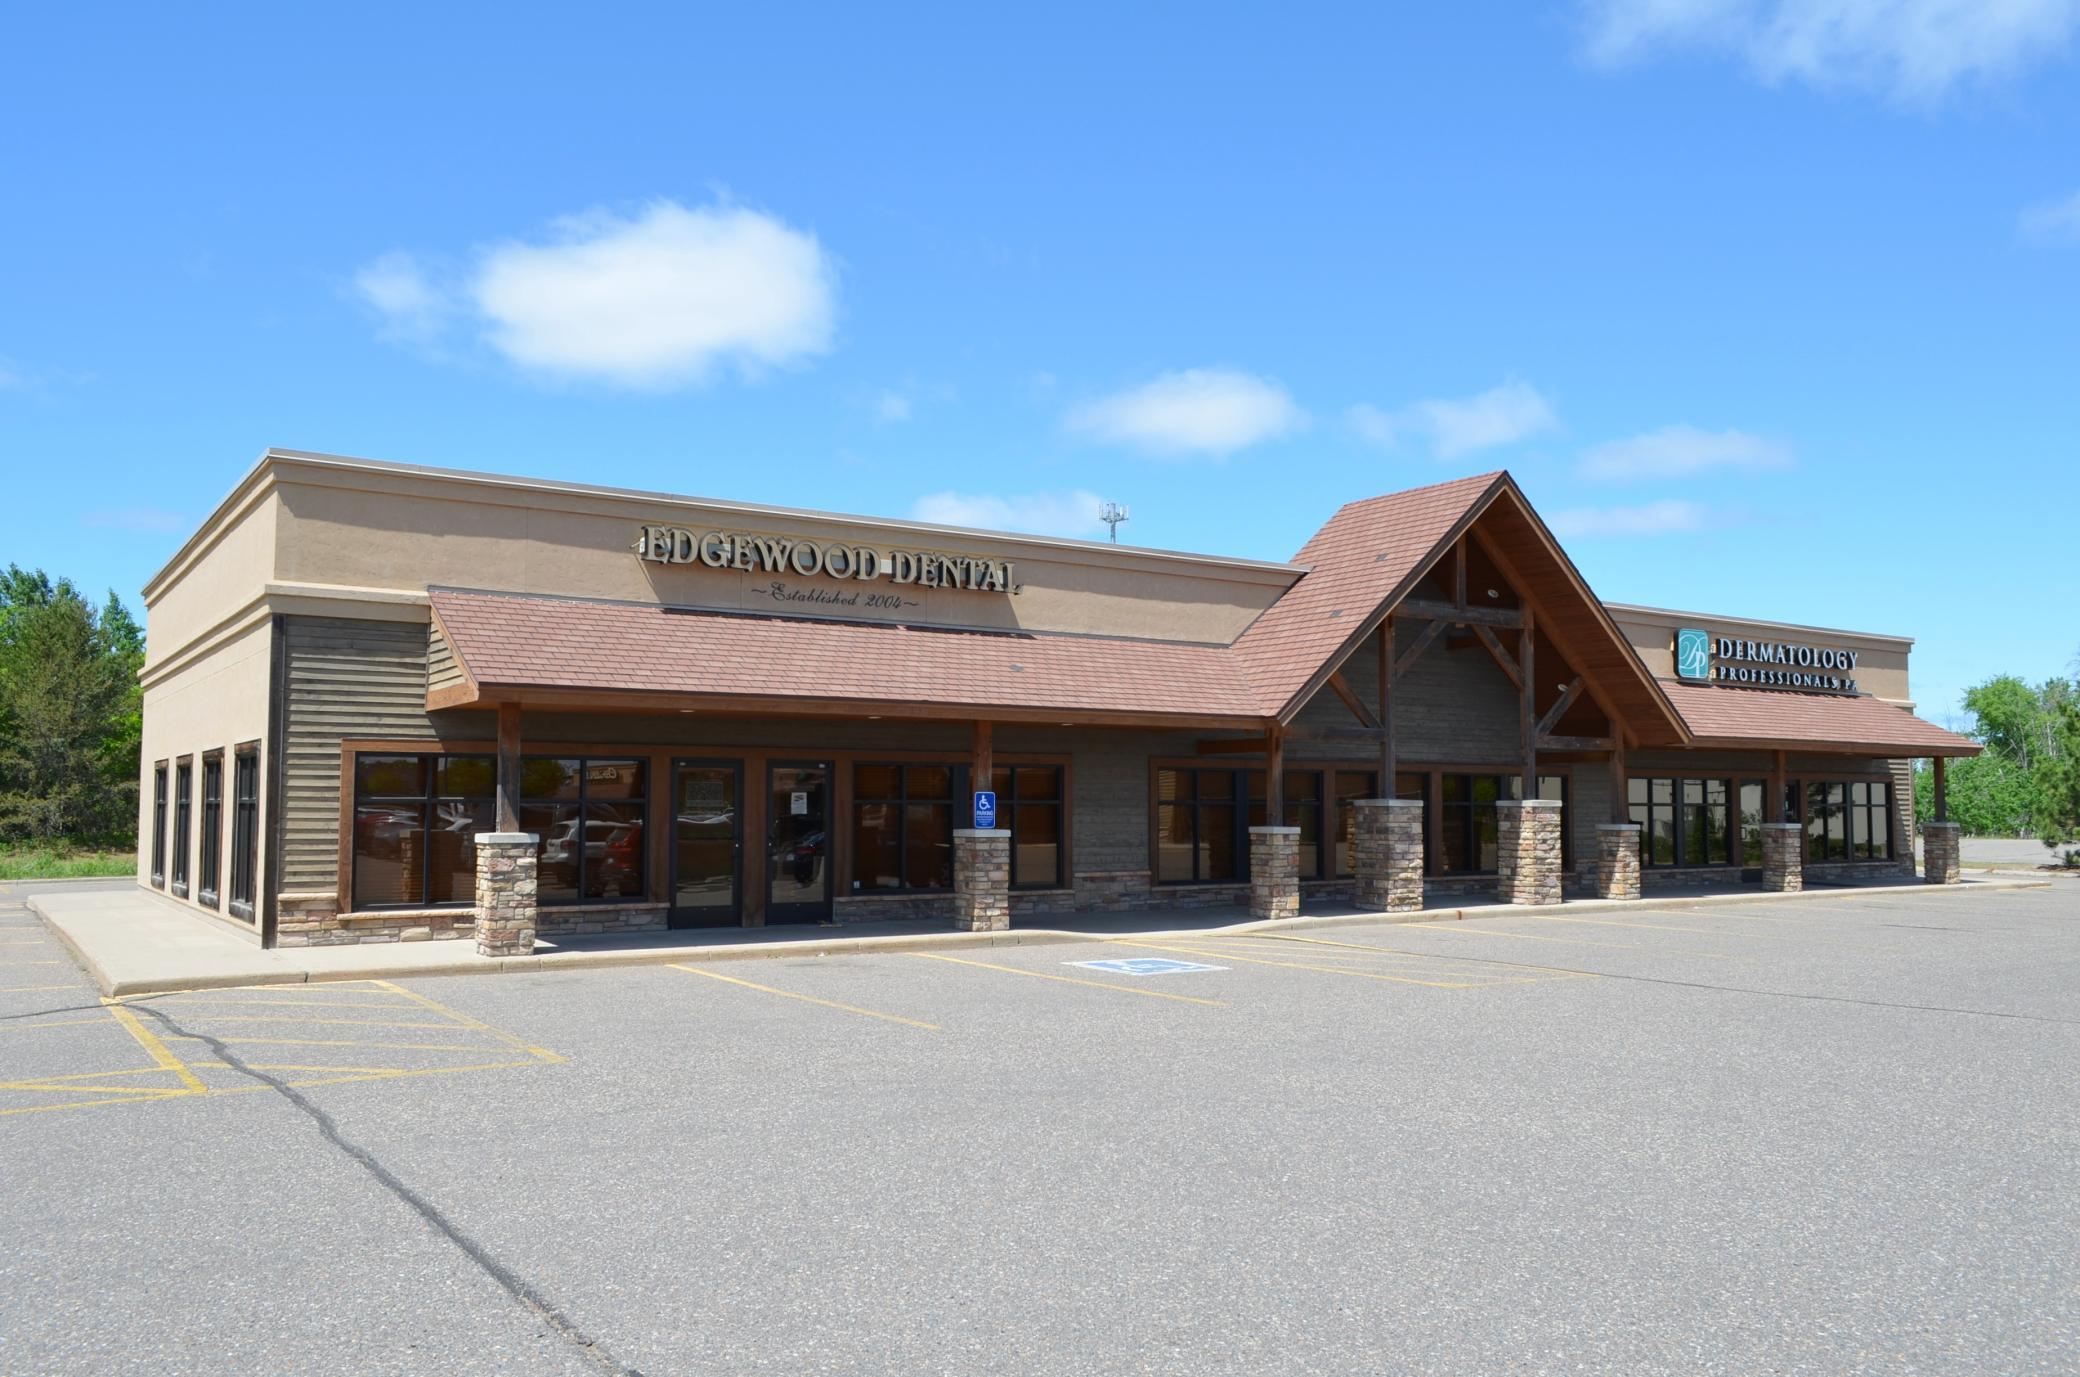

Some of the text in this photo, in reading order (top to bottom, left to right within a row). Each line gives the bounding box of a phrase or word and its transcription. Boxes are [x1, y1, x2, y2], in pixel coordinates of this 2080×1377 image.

[641, 525, 1023, 595] EDGEWOOD DENTAL
[770, 581, 902, 609] Established 2004
[1719, 638, 1858, 670] DERMATOLOGY
